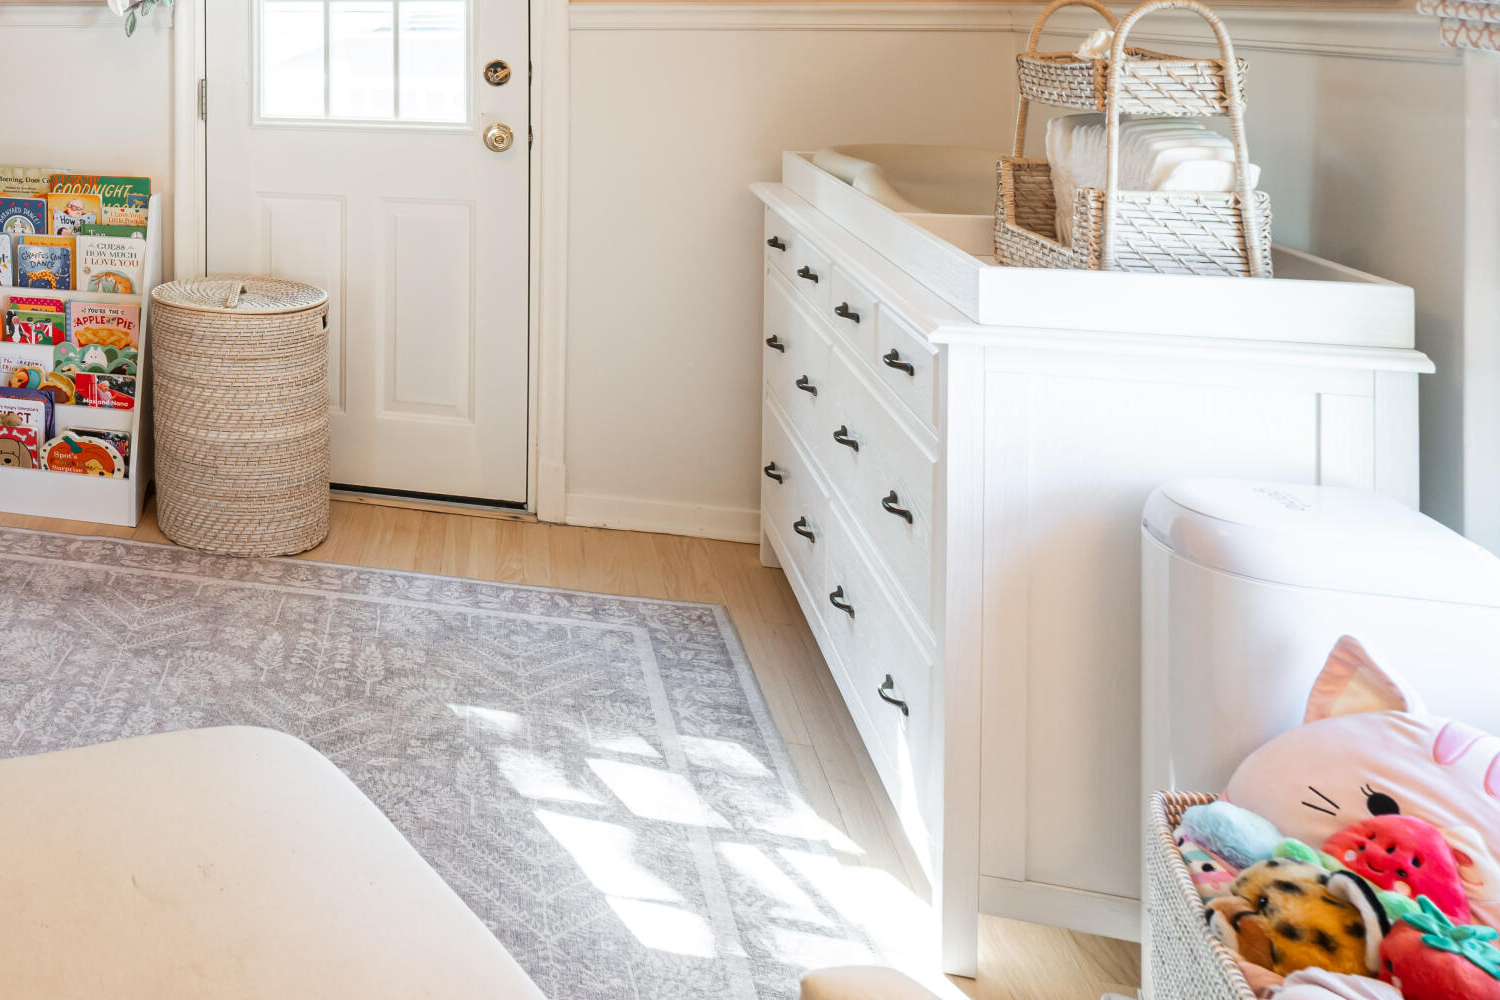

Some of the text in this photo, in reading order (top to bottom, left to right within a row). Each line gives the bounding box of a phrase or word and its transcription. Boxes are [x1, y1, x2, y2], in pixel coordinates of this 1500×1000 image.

[52, 183, 134, 198] GOODNIGHT
[60, 215, 76, 225] How
[86, 249, 137, 259] HOW MUCH
[29, 259, 55, 269] DANCE
[91, 257, 116, 266] LOVE
[118, 259, 139, 267] YOU
[76, 315, 106, 327] APPLE
[116, 316, 134, 330] PIE
[53, 450, 78, 459] Spot's
